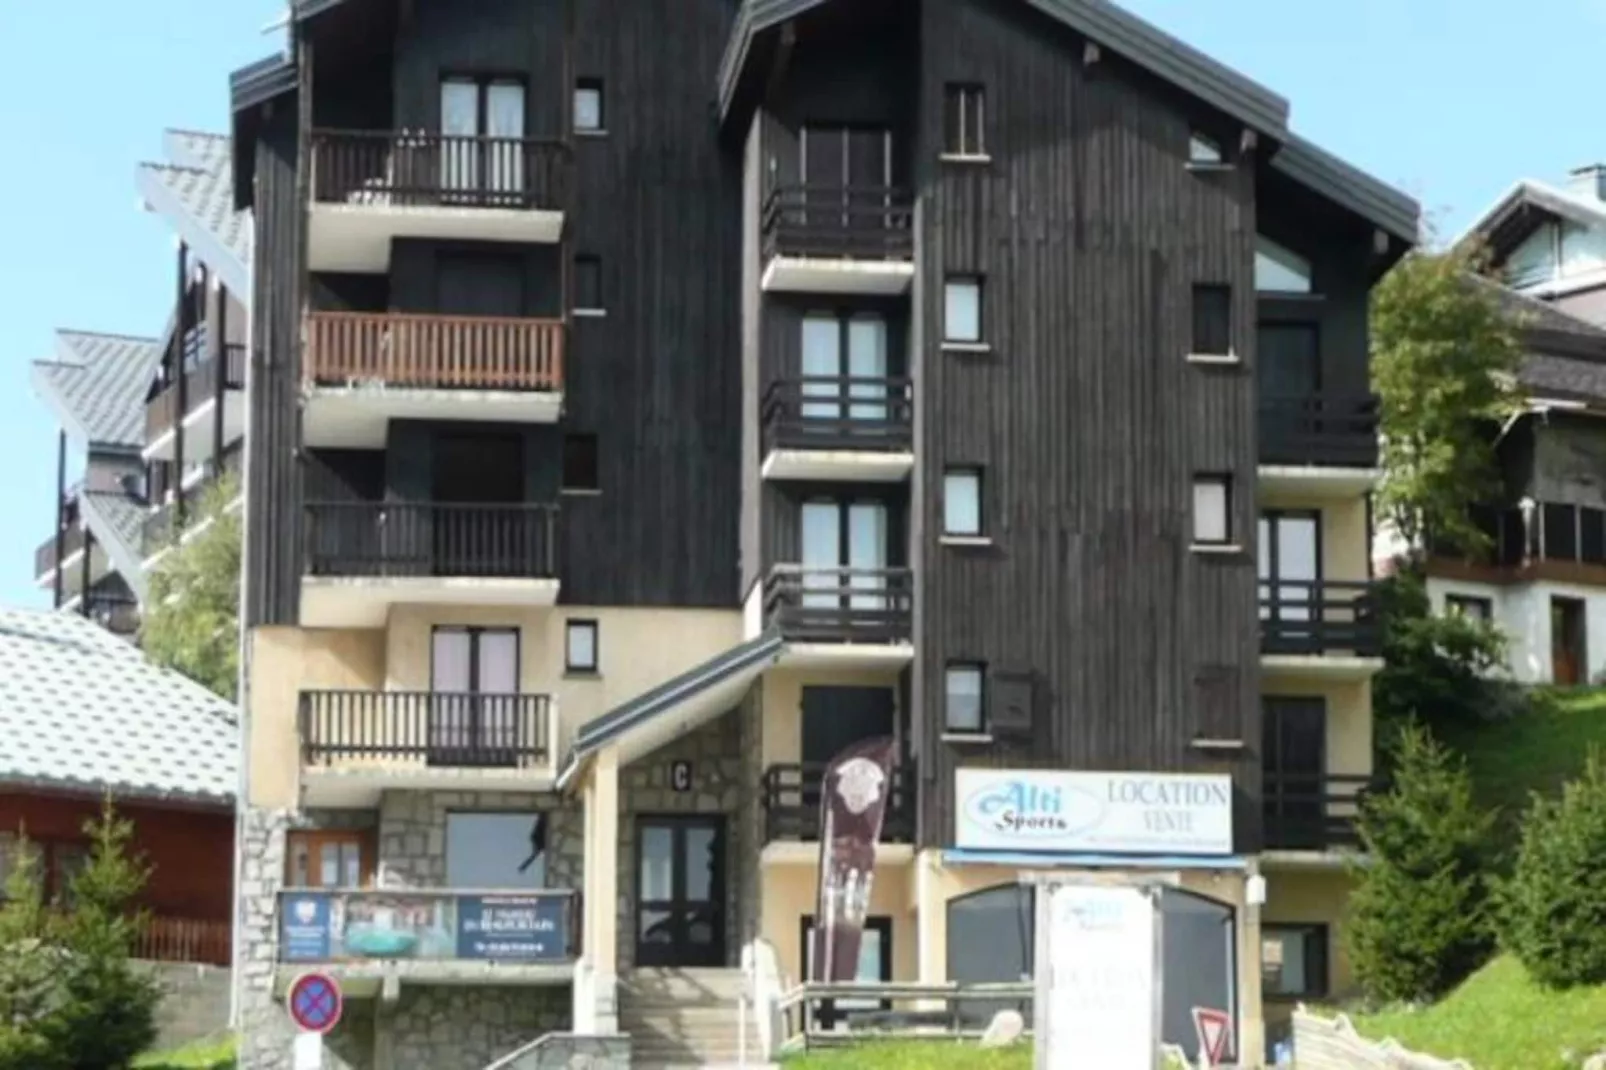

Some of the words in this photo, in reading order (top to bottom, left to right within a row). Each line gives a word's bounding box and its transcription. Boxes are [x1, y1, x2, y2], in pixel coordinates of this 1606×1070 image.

[978, 780, 1062, 816] Alti
[1107, 779, 1230, 807] LOCATION
[994, 810, 1068, 832] Sports
[1142, 811, 1196, 833] VENTE
